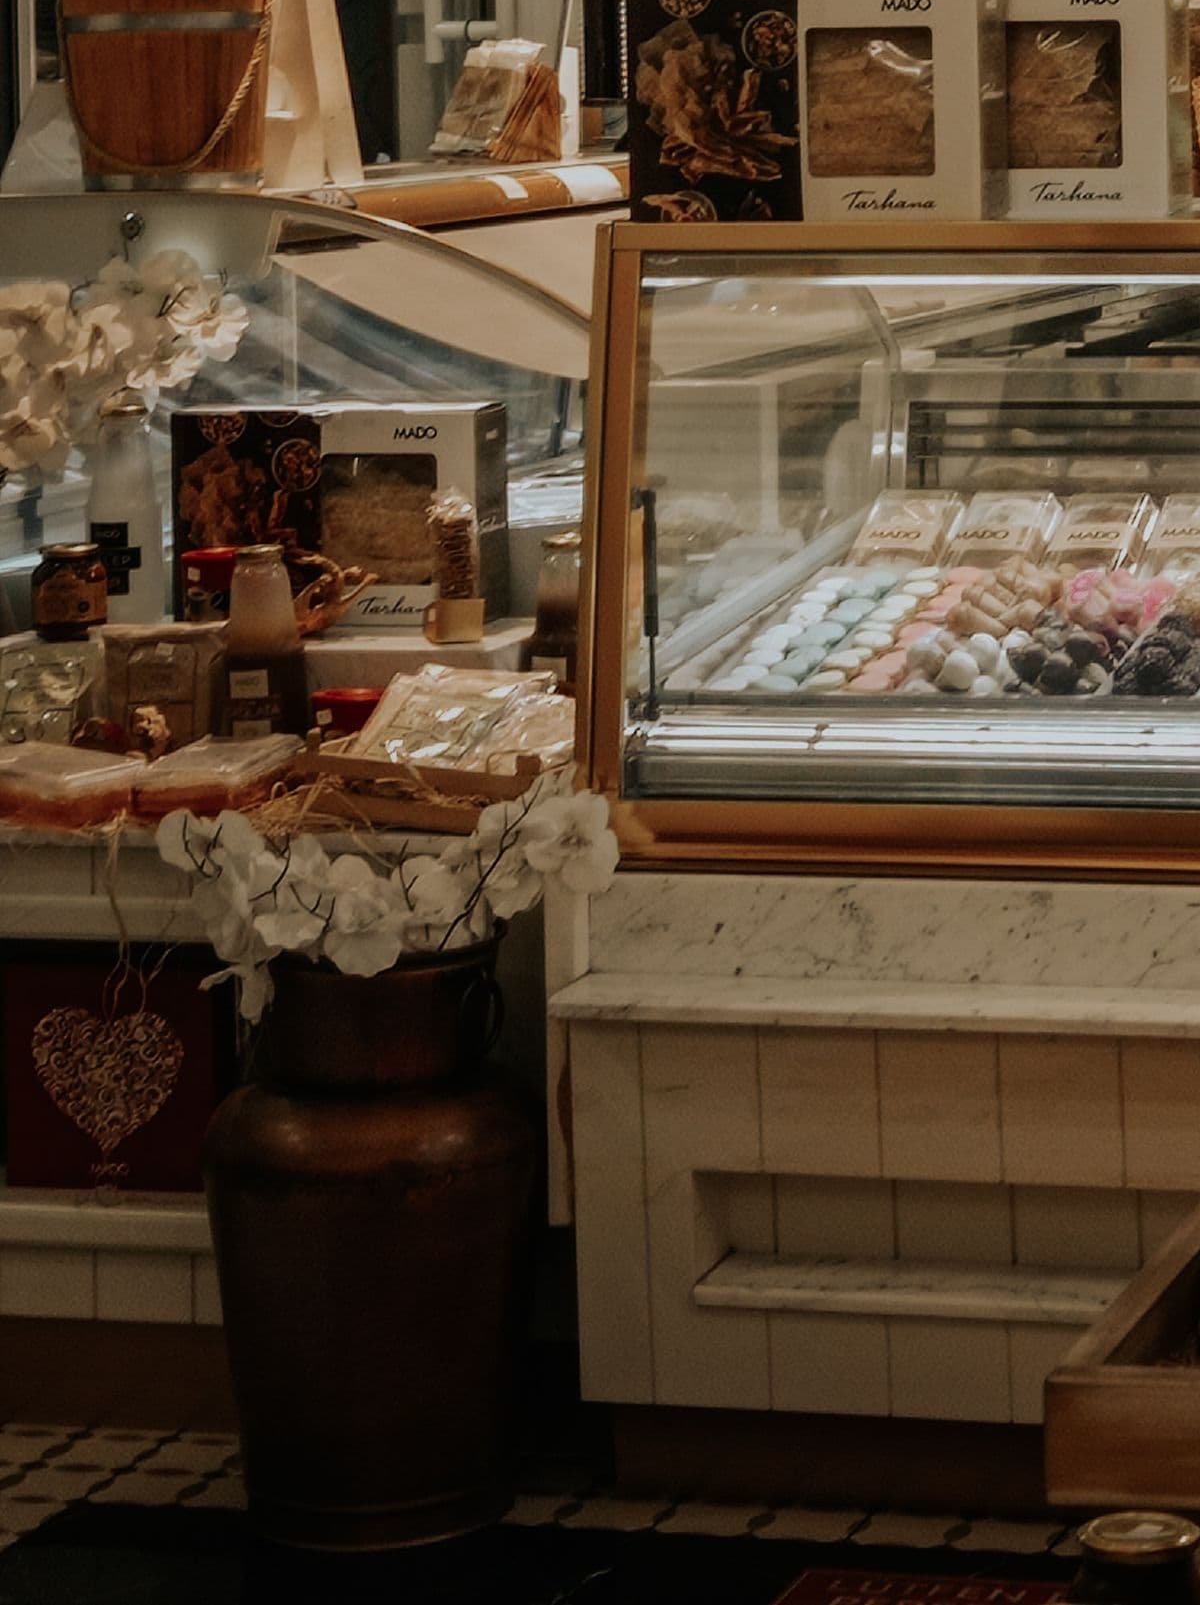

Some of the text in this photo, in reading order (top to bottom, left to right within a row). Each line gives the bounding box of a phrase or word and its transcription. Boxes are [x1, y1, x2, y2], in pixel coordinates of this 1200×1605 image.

[841, 188, 938, 212] Tarhana
[1029, 180, 1124, 203] Tarhana
[393, 426, 438, 440] MADO
[357, 595, 426, 616] Tarha
